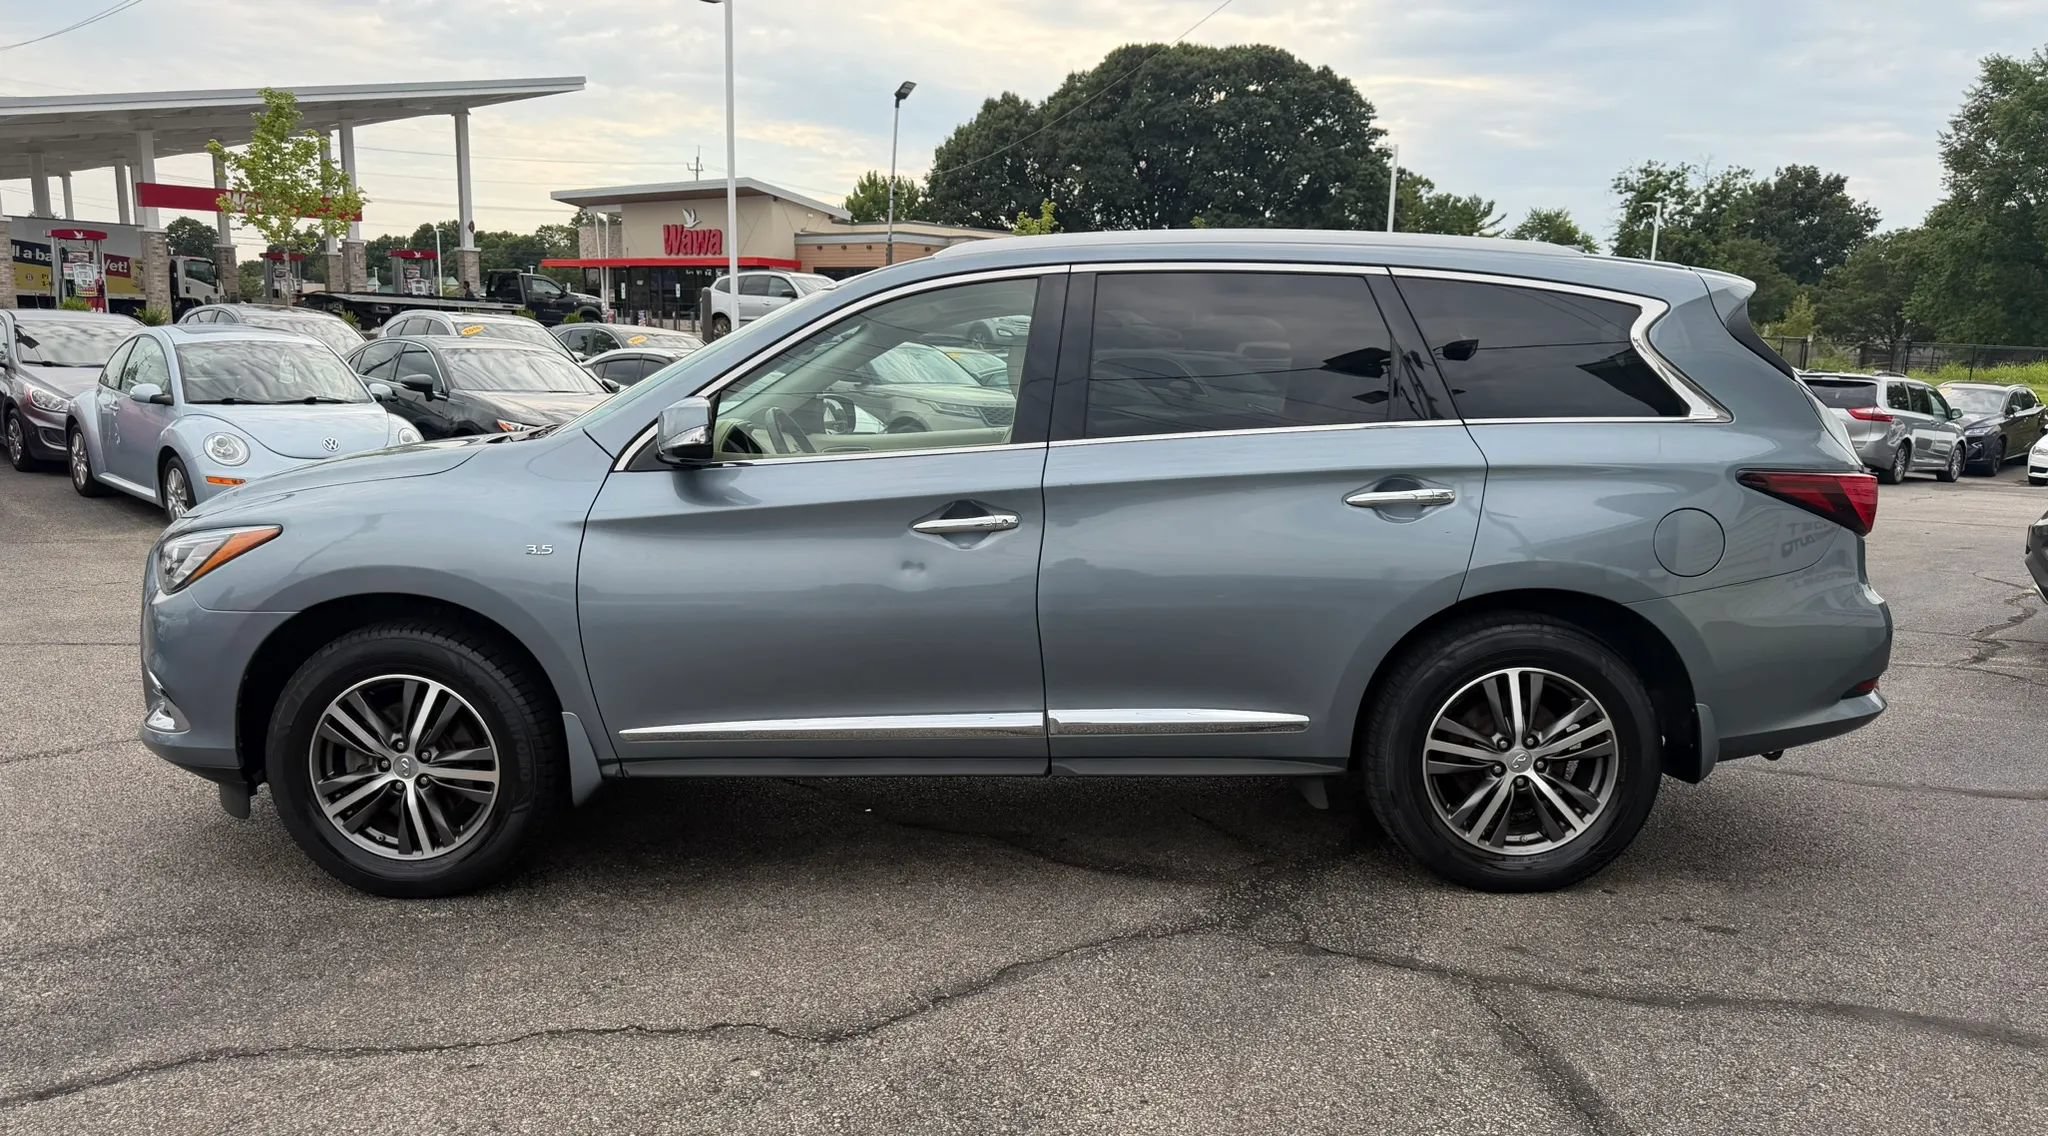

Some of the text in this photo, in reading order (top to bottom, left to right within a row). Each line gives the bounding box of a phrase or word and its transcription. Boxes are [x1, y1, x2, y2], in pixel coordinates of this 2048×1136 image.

[663, 224, 723, 256] Wawa
[23, 249, 33, 259] a
[525, 544, 553, 555] 3.5
